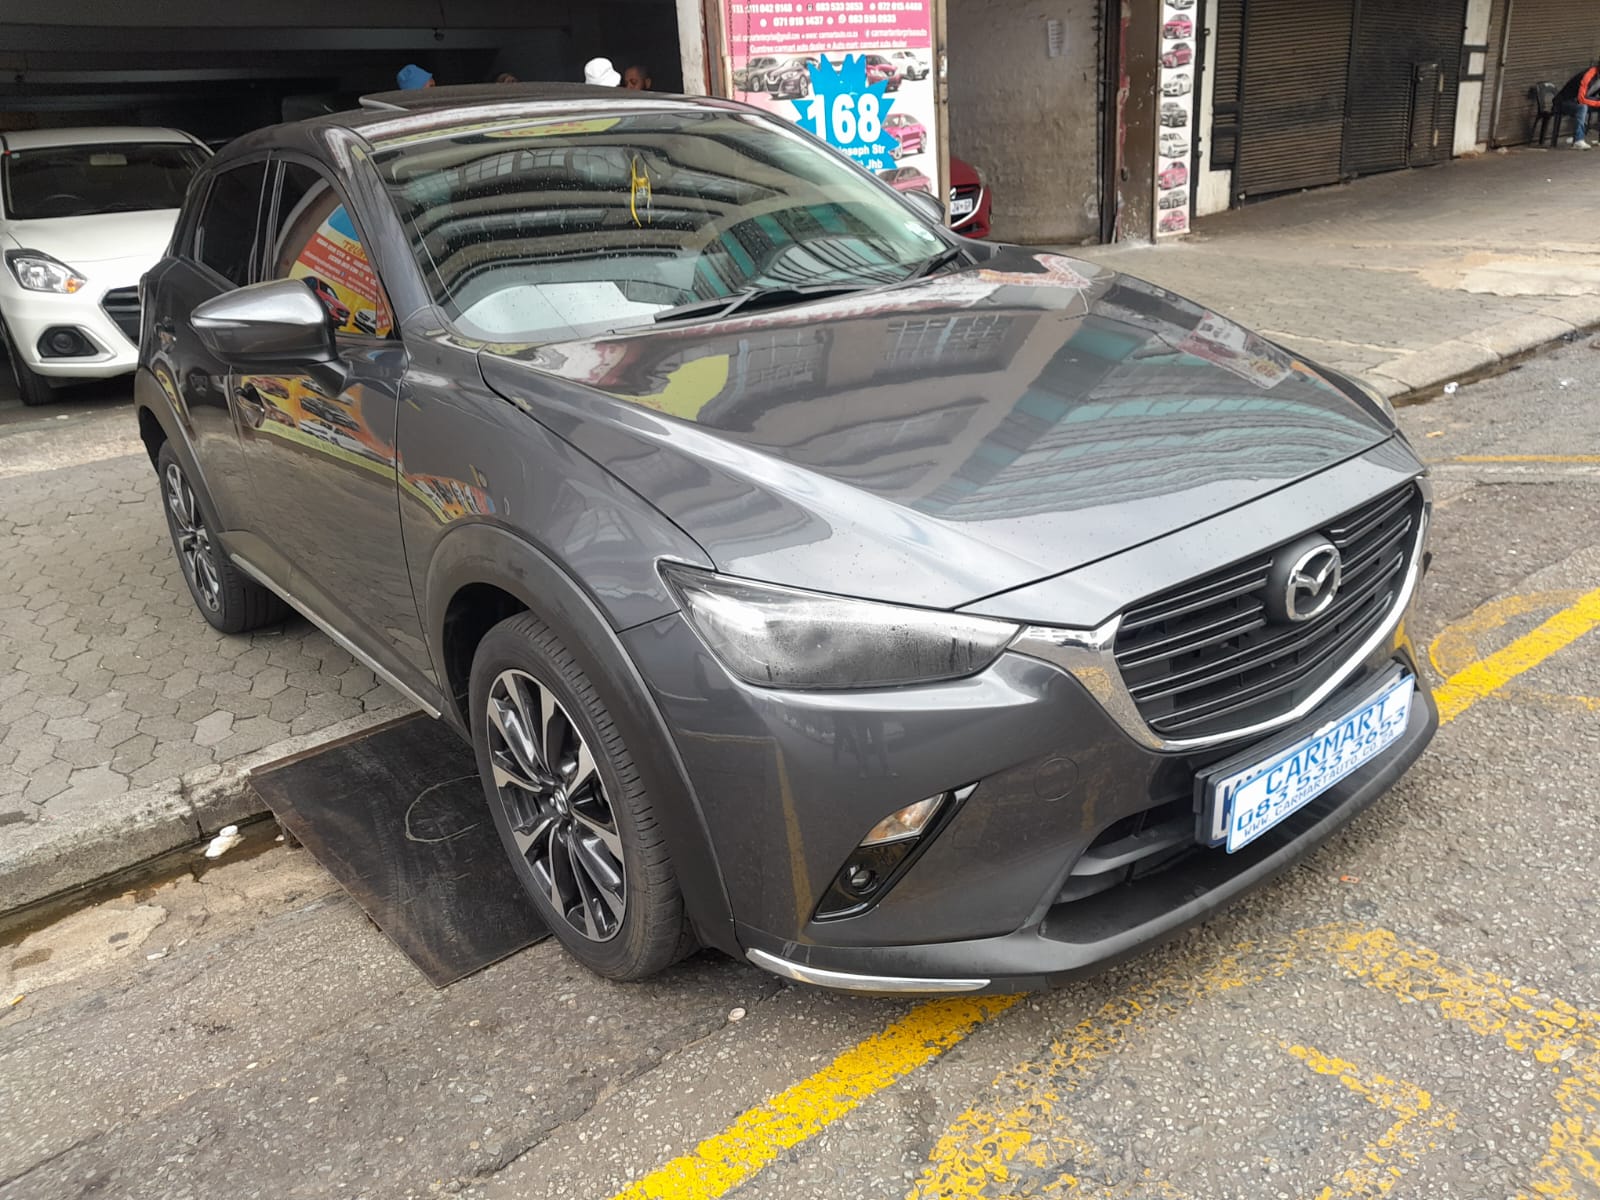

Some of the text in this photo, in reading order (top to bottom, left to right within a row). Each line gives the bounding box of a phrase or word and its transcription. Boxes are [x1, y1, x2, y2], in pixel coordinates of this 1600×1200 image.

[806, 93, 881, 144] 168
[866, 159, 884, 169] Jhb
[872, 144, 886, 154] Str
[1237, 785, 1288, 832] 083
[1297, 749, 1344, 789] 533
[1350, 706, 1406, 754] 3653
[1266, 696, 1390, 795] CARMART
